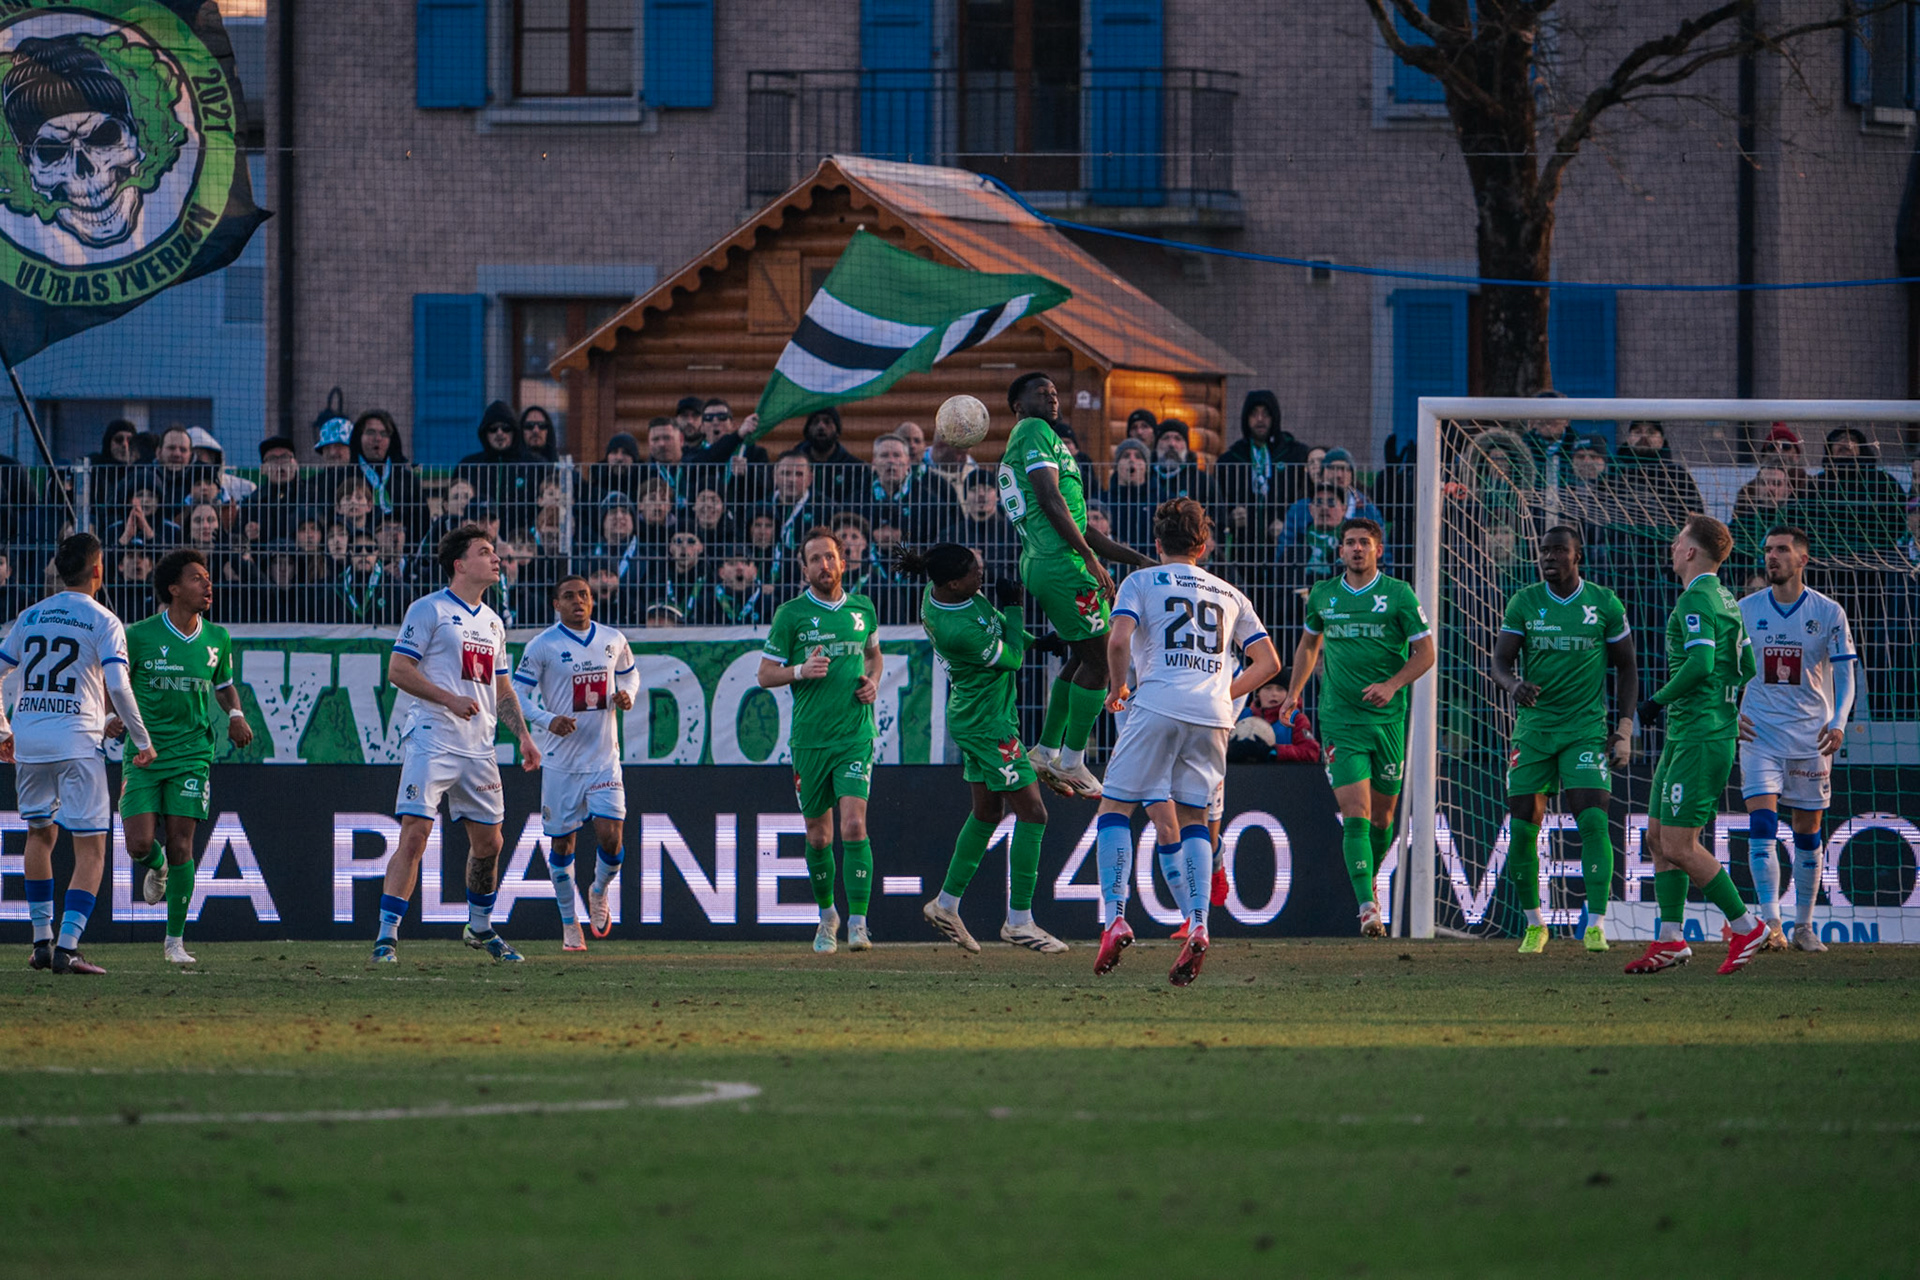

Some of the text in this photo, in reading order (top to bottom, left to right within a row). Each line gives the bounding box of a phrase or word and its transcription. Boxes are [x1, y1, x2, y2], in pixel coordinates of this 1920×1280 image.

[191, 68, 233, 132] 2021
[15, 202, 218, 301] ULTRAS YVERDON
[1174, 573, 1206, 583] Luzerner
[1175, 579, 1234, 598] Kantonalbank
[42, 608, 69, 616] Luzerner
[38, 616, 94, 632] Kantonalbank
[1164, 597, 1224, 654] 29
[464, 643, 494, 656] OTTO'S
[1530, 636, 1597, 651] KINETIK
[1765, 648, 1801, 657] OTTO'S
[24, 635, 80, 694] 22
[1165, 653, 1222, 674] WINKLER
[574, 673, 607, 685] OTTO'S
[1579, 751, 1594, 763] GL
[184, 778, 199, 791] GL
[1670, 783, 1684, 804] 8
[112, 811, 281, 922] LA
[333, 812, 821, 924] PLAINE
[1355, 860, 1367, 870] 25
[1591, 864, 1597, 873] 2
[856, 869, 867, 878] 32
